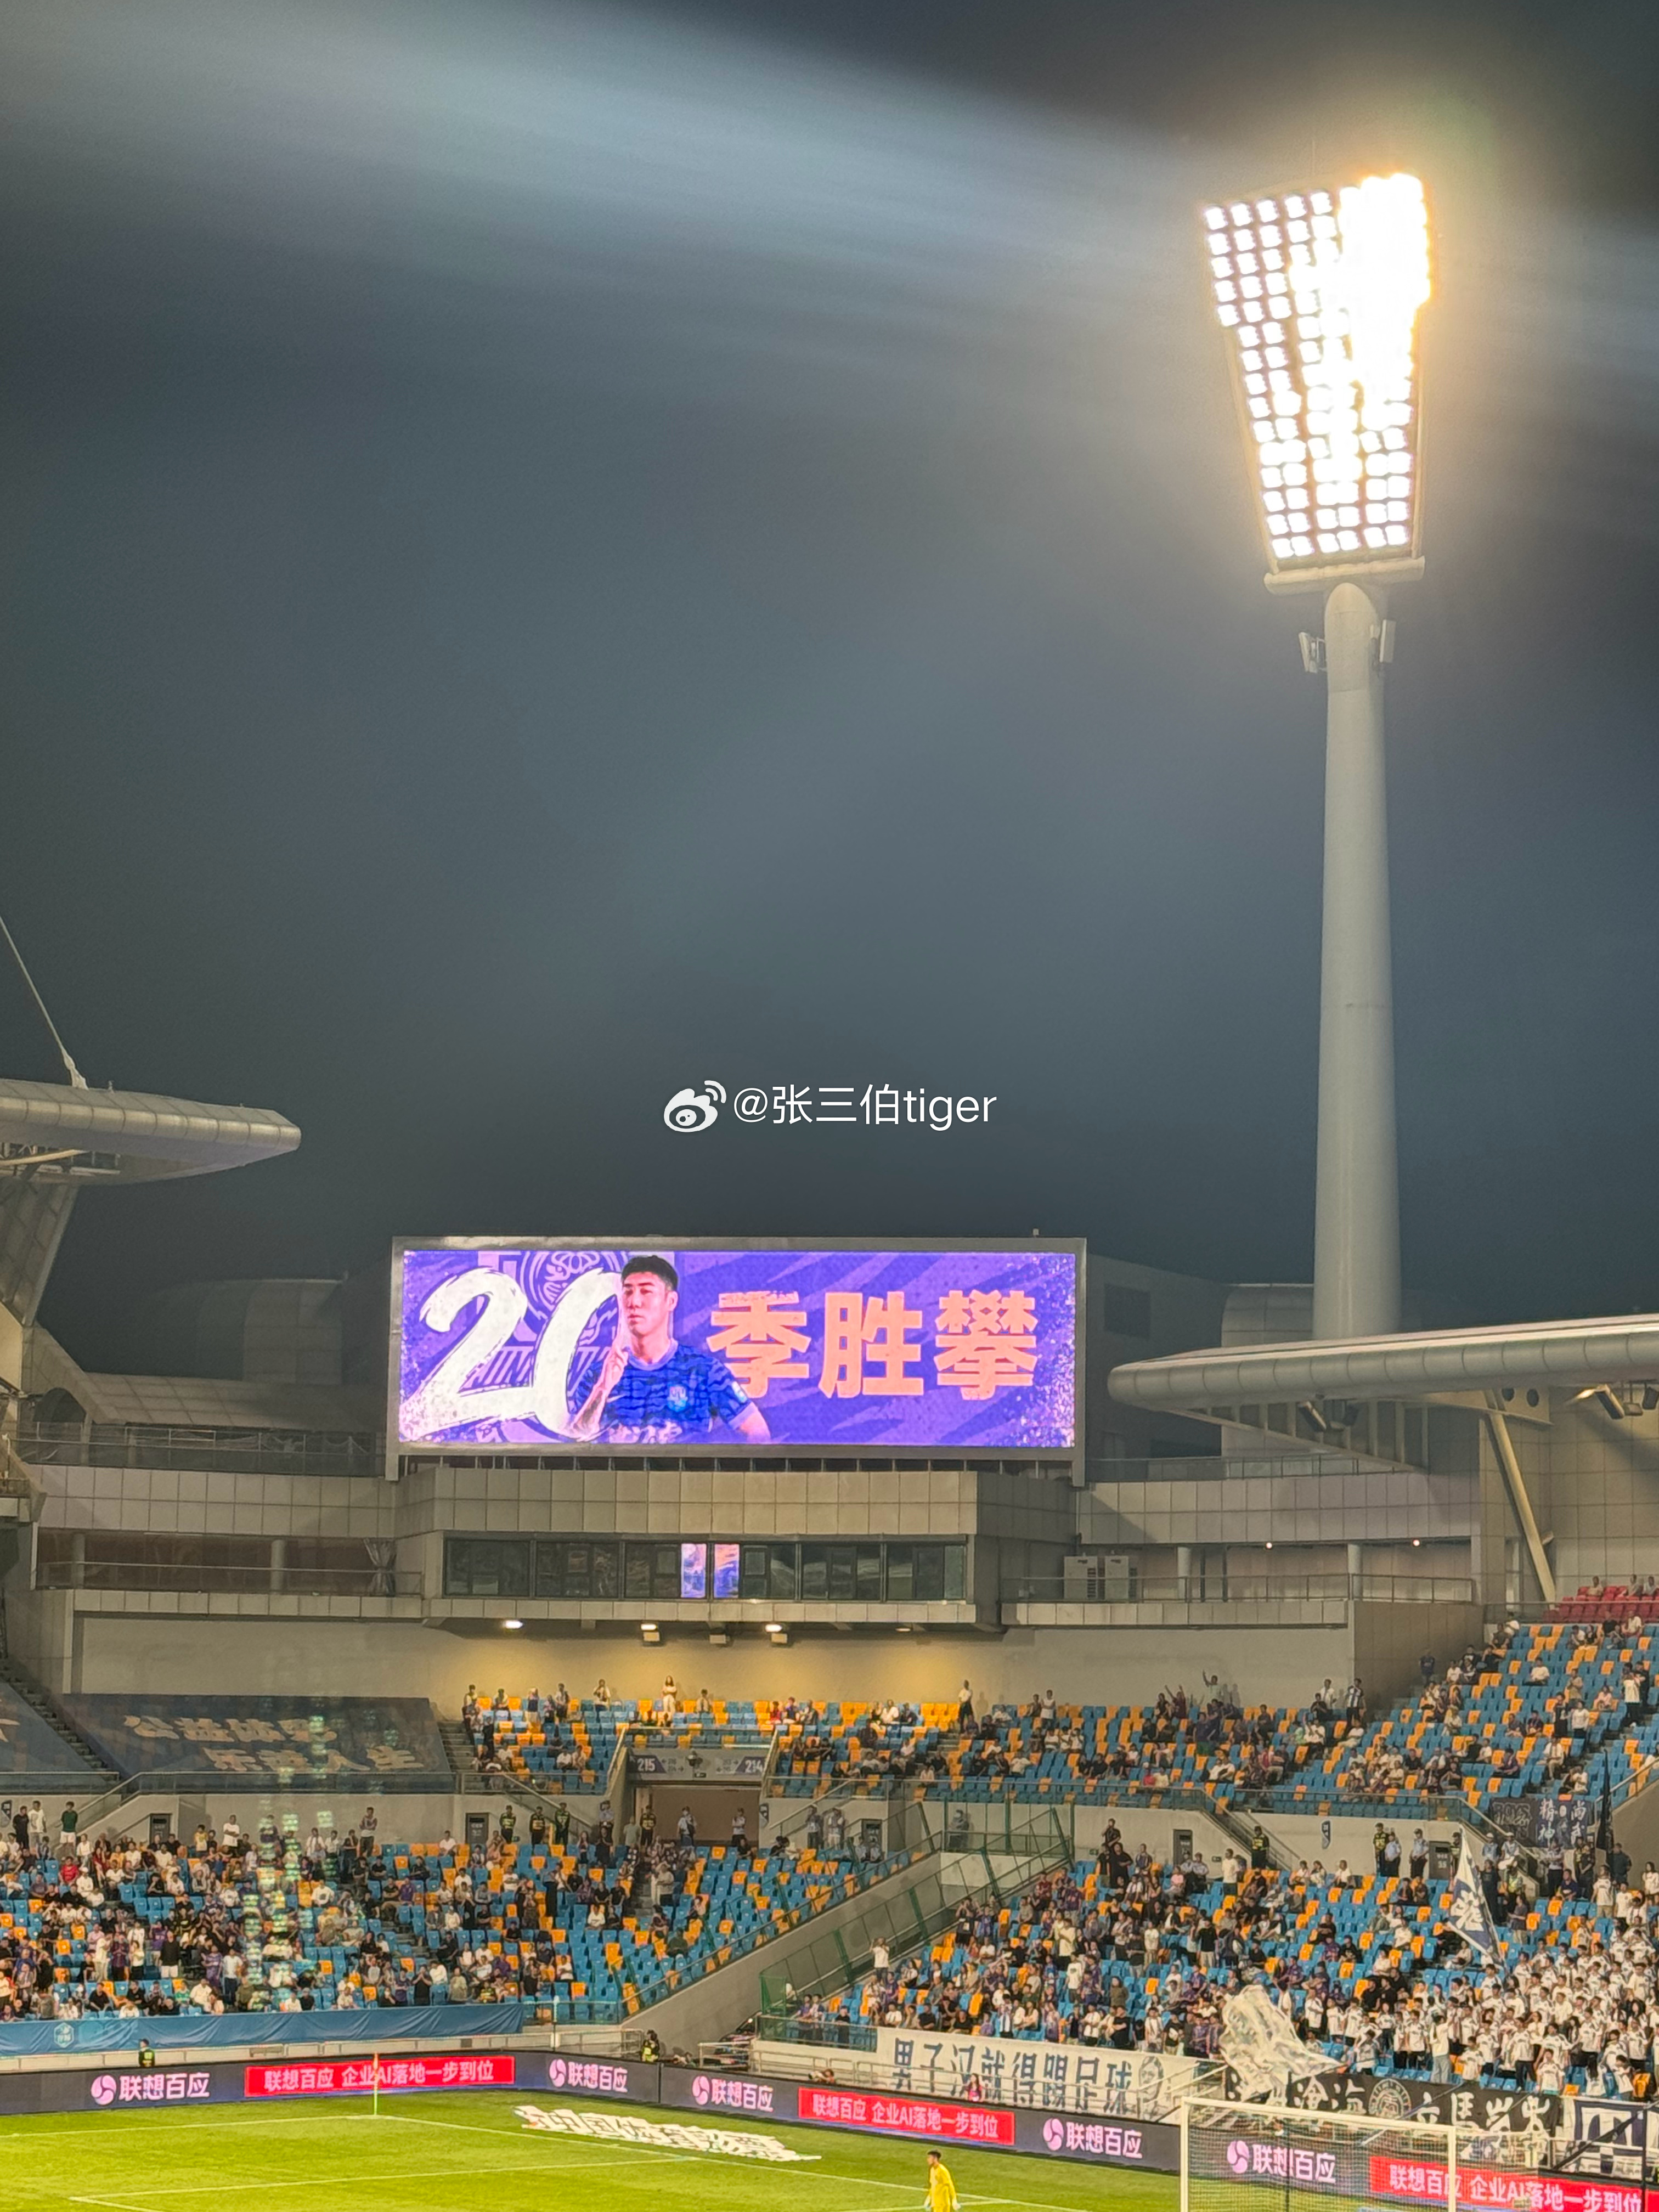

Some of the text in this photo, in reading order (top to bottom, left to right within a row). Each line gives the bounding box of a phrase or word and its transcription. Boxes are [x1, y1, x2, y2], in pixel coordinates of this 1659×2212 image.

[705, 1290, 1039, 1400] 季胜攀
[637, 1758, 656, 1771] 215
[745, 1759, 763, 1773] 214
[119, 2072, 210, 2102] 联想百应
[264, 2059, 494, 2091] 联想百应 企业AI落地一步到位
[567, 2061, 628, 2094] 联想百应
[711, 2078, 774, 2113] 联想百应
[812, 2094, 1000, 2138] 联想百应 企业AI落地一步到位
[1066, 2121, 1143, 2160] 联想百应
[1252, 2143, 1336, 2184] 联想百应
[1389, 2164, 1462, 2202] 联想百应
